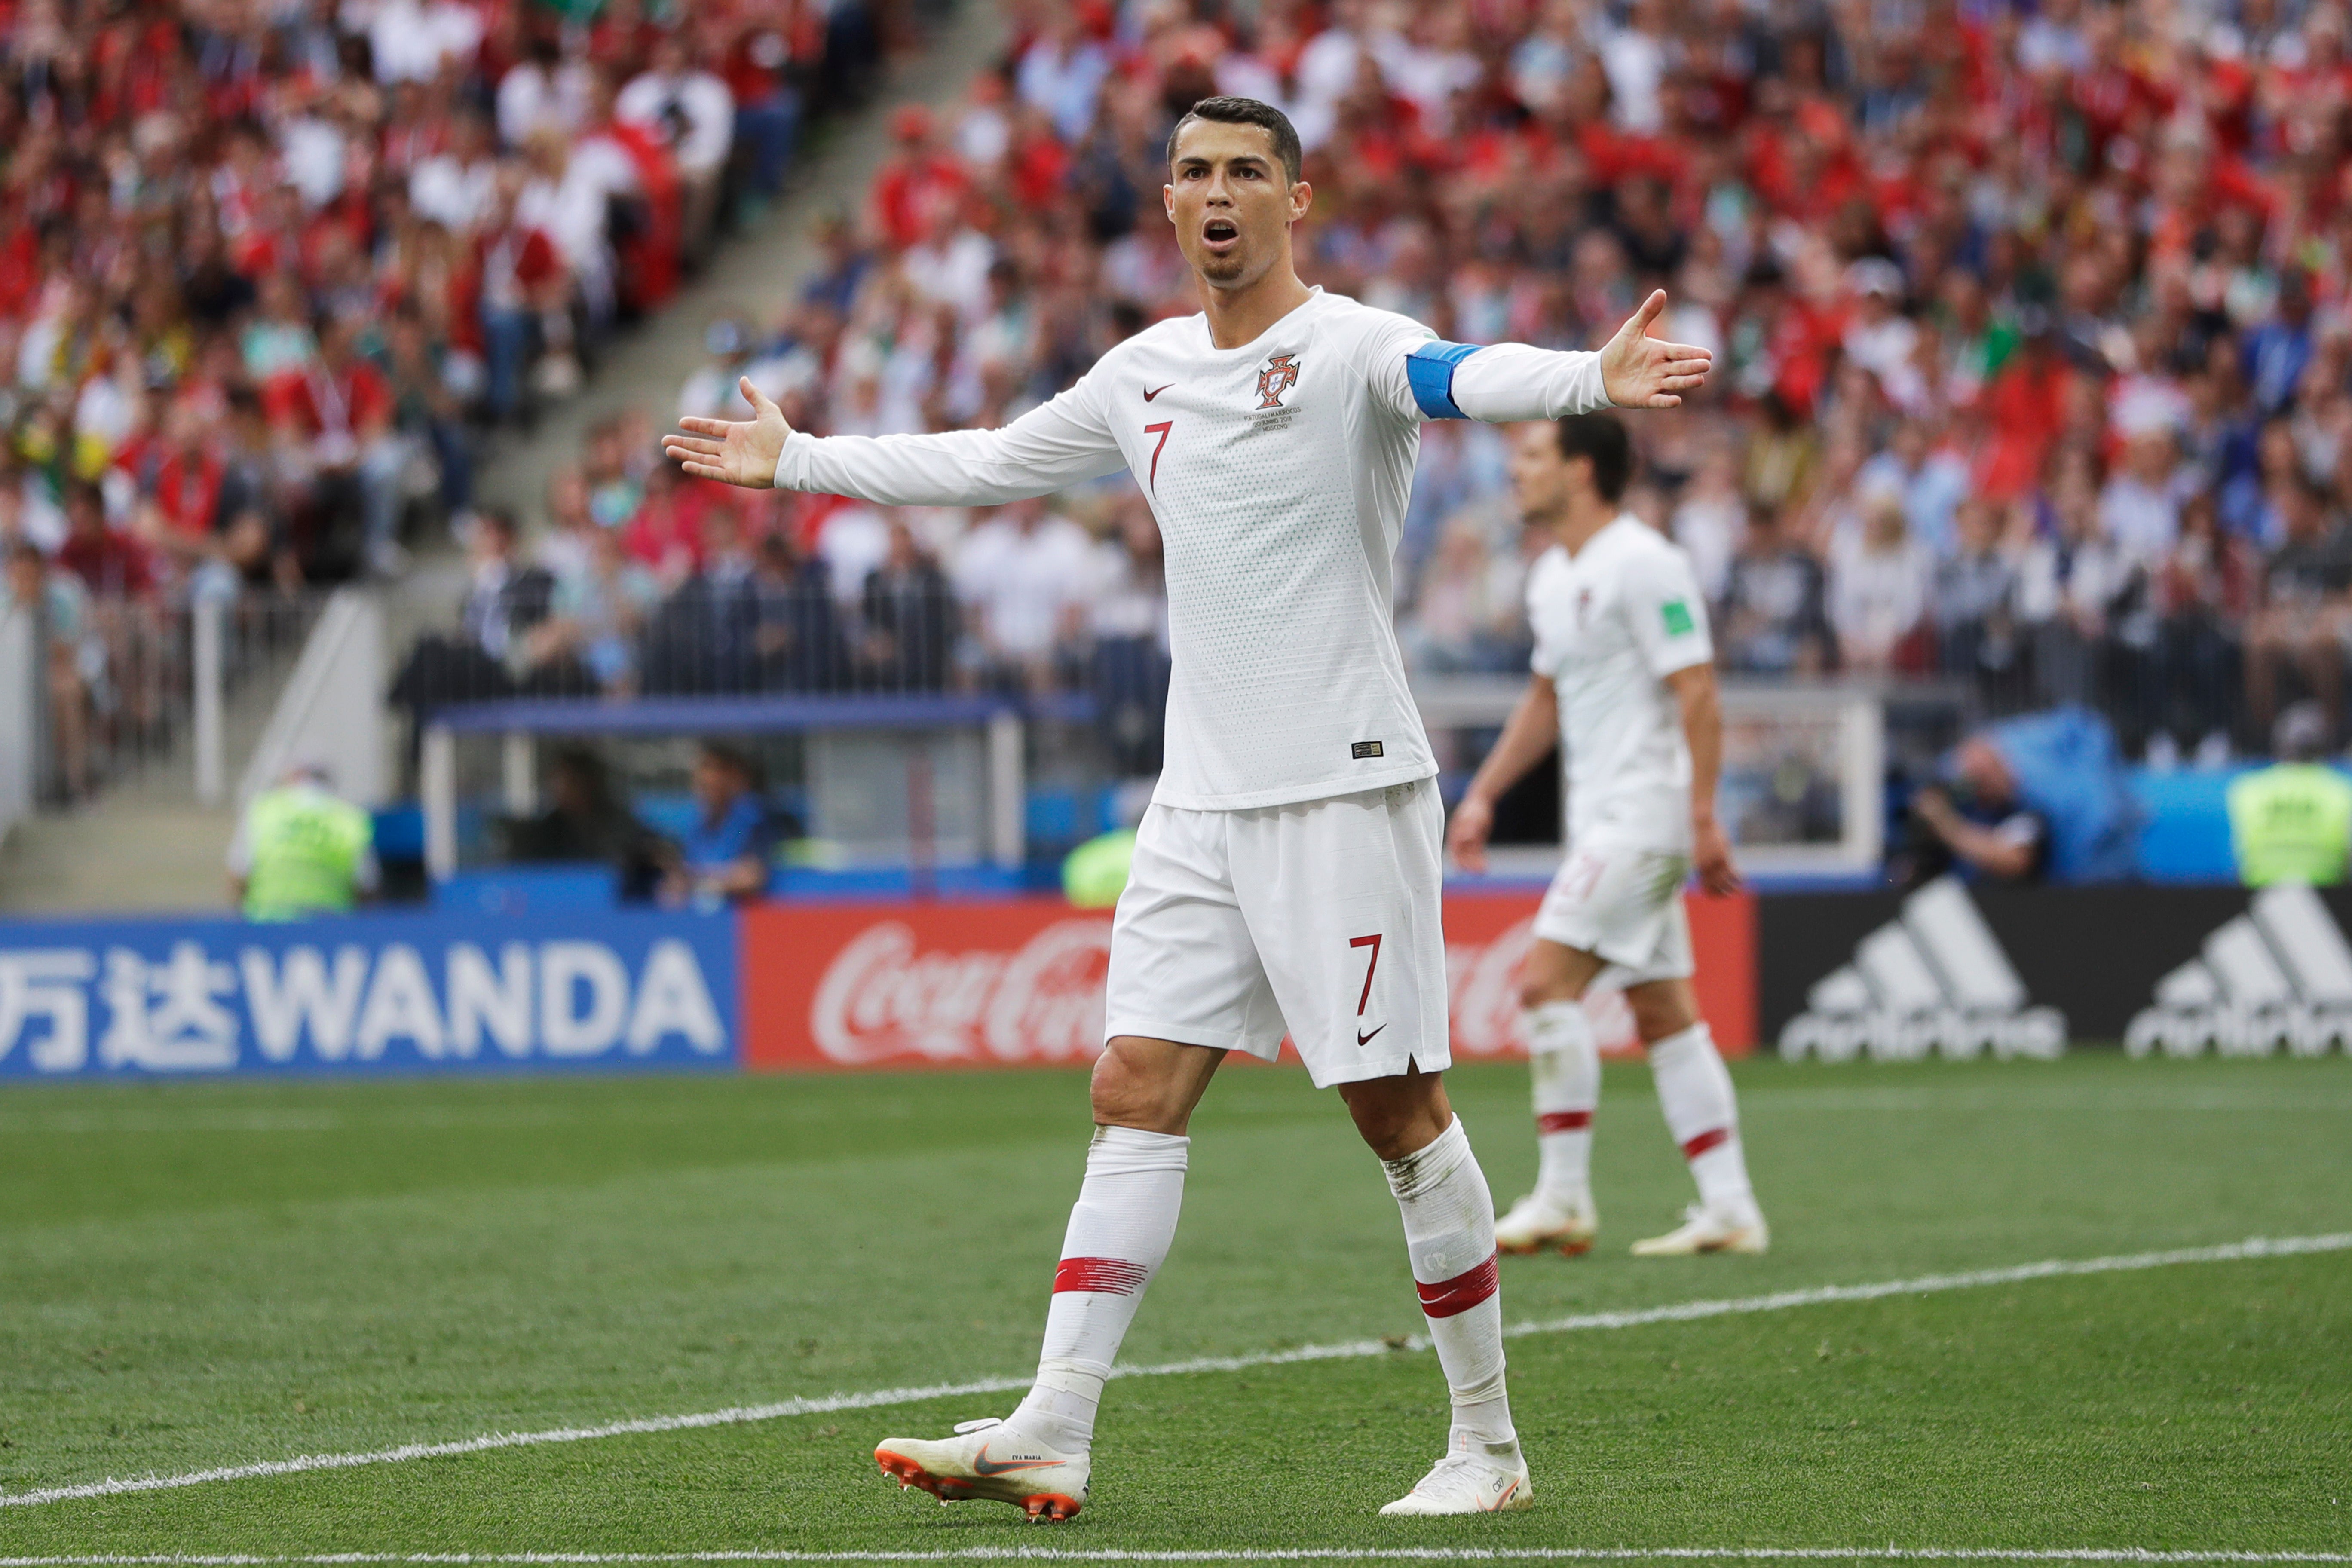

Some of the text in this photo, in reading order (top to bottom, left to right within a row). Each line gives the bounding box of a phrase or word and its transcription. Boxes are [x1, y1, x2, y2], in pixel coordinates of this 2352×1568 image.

[1243, 407, 1302, 421] PORTUGAL/MARROCOS
[1143, 420, 1174, 500] 7
[239, 941, 727, 1058] WANDA
[1349, 934, 1382, 1016] 7
